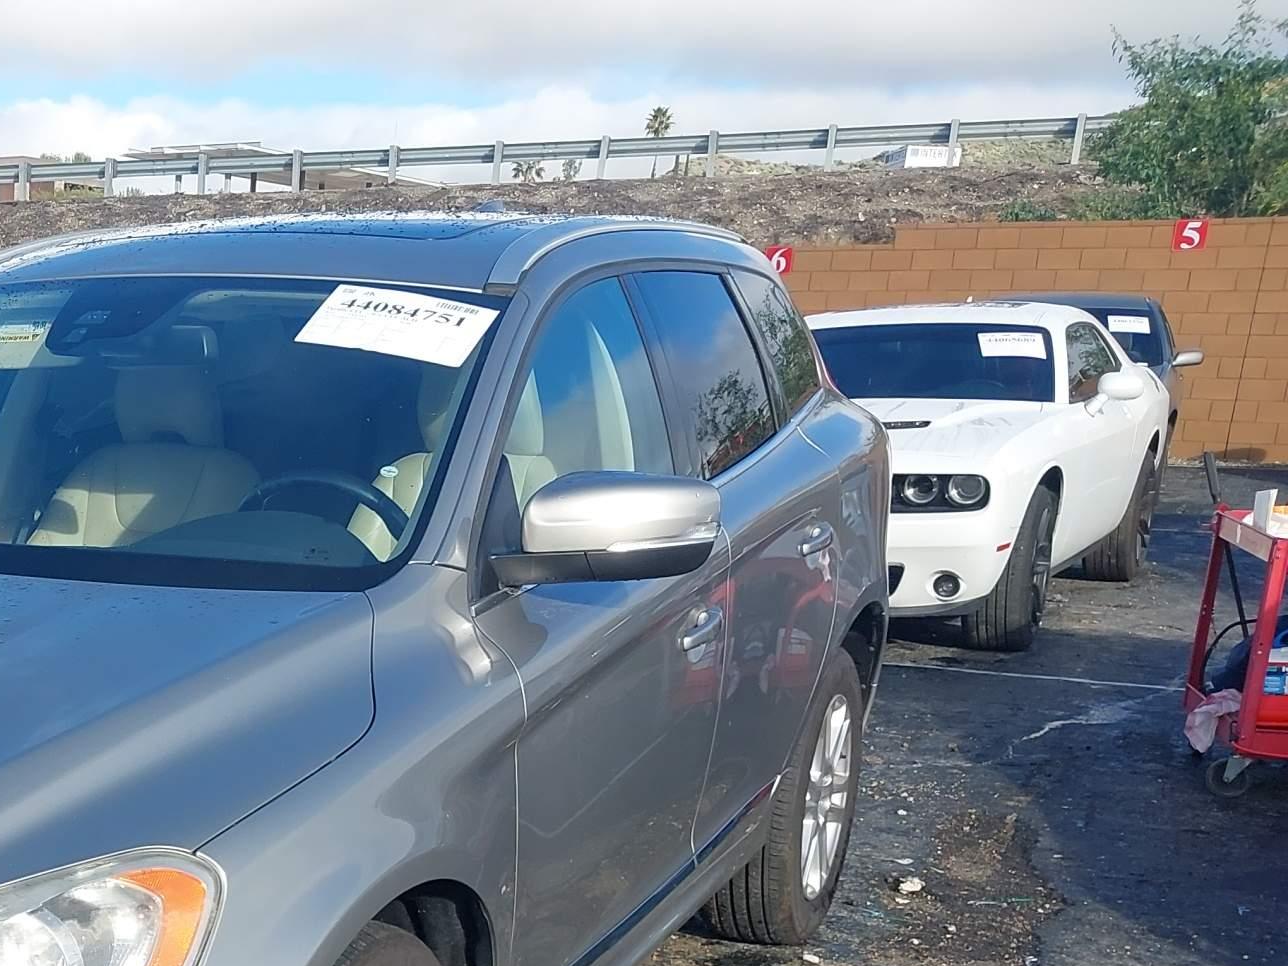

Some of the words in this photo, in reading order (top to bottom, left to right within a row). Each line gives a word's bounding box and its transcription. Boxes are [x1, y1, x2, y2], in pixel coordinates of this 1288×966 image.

[1179, 221, 1203, 249] 5
[772, 248, 787, 273] 6
[340, 298, 466, 327] 44084751
